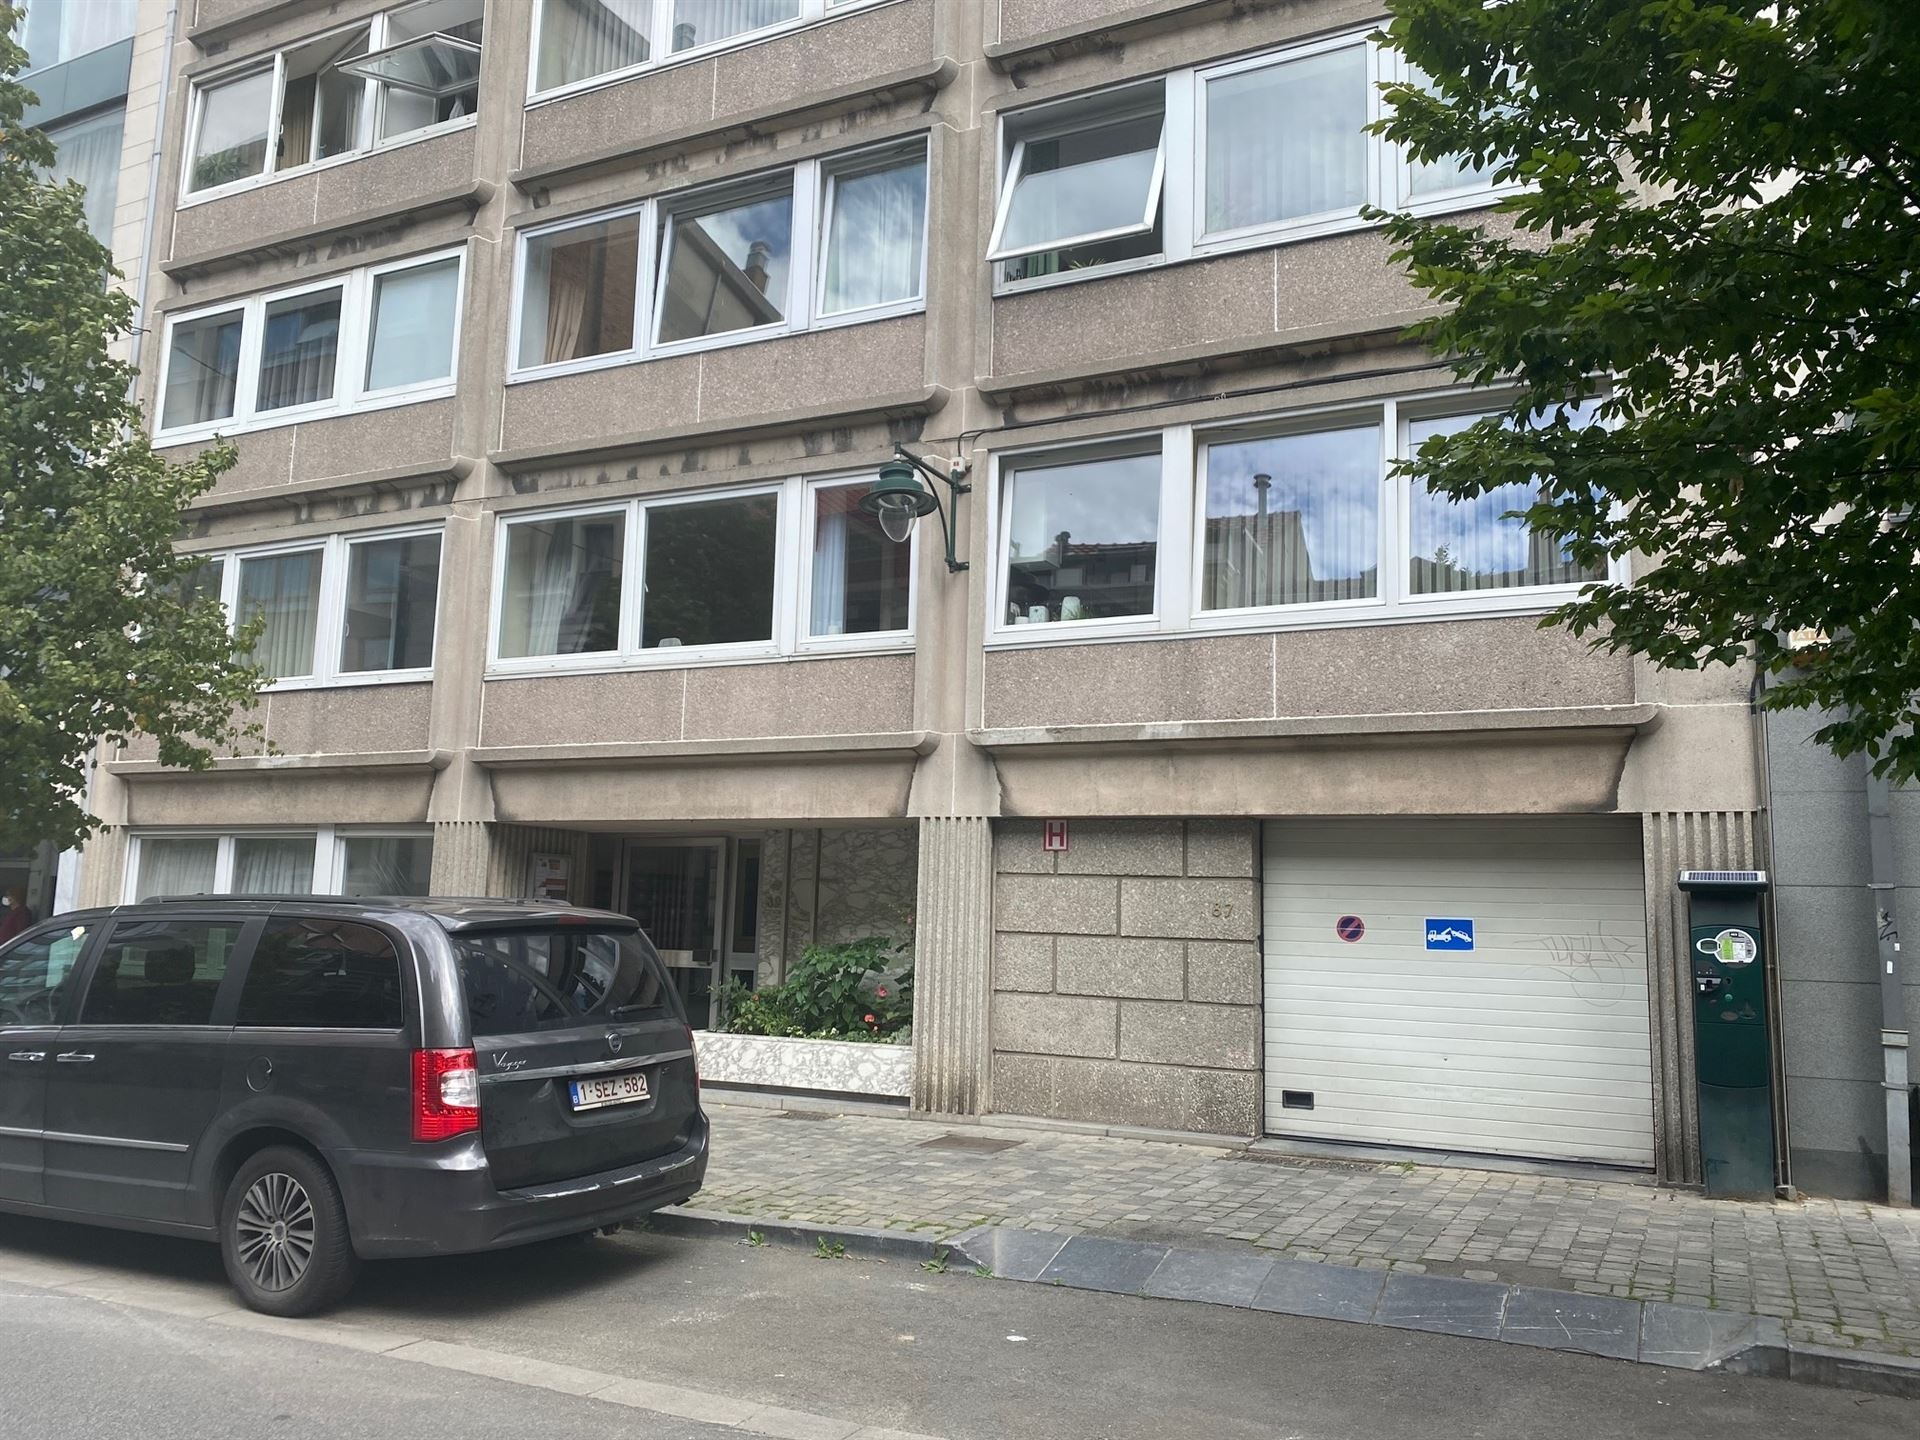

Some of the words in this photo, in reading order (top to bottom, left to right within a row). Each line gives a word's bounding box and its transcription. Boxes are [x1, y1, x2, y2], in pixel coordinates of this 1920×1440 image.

[1048, 822, 1065, 847] H
[492, 1051, 527, 1071] Voyager
[580, 1075, 646, 1101] 1-SEZ-582
[572, 1095, 579, 1104] B
